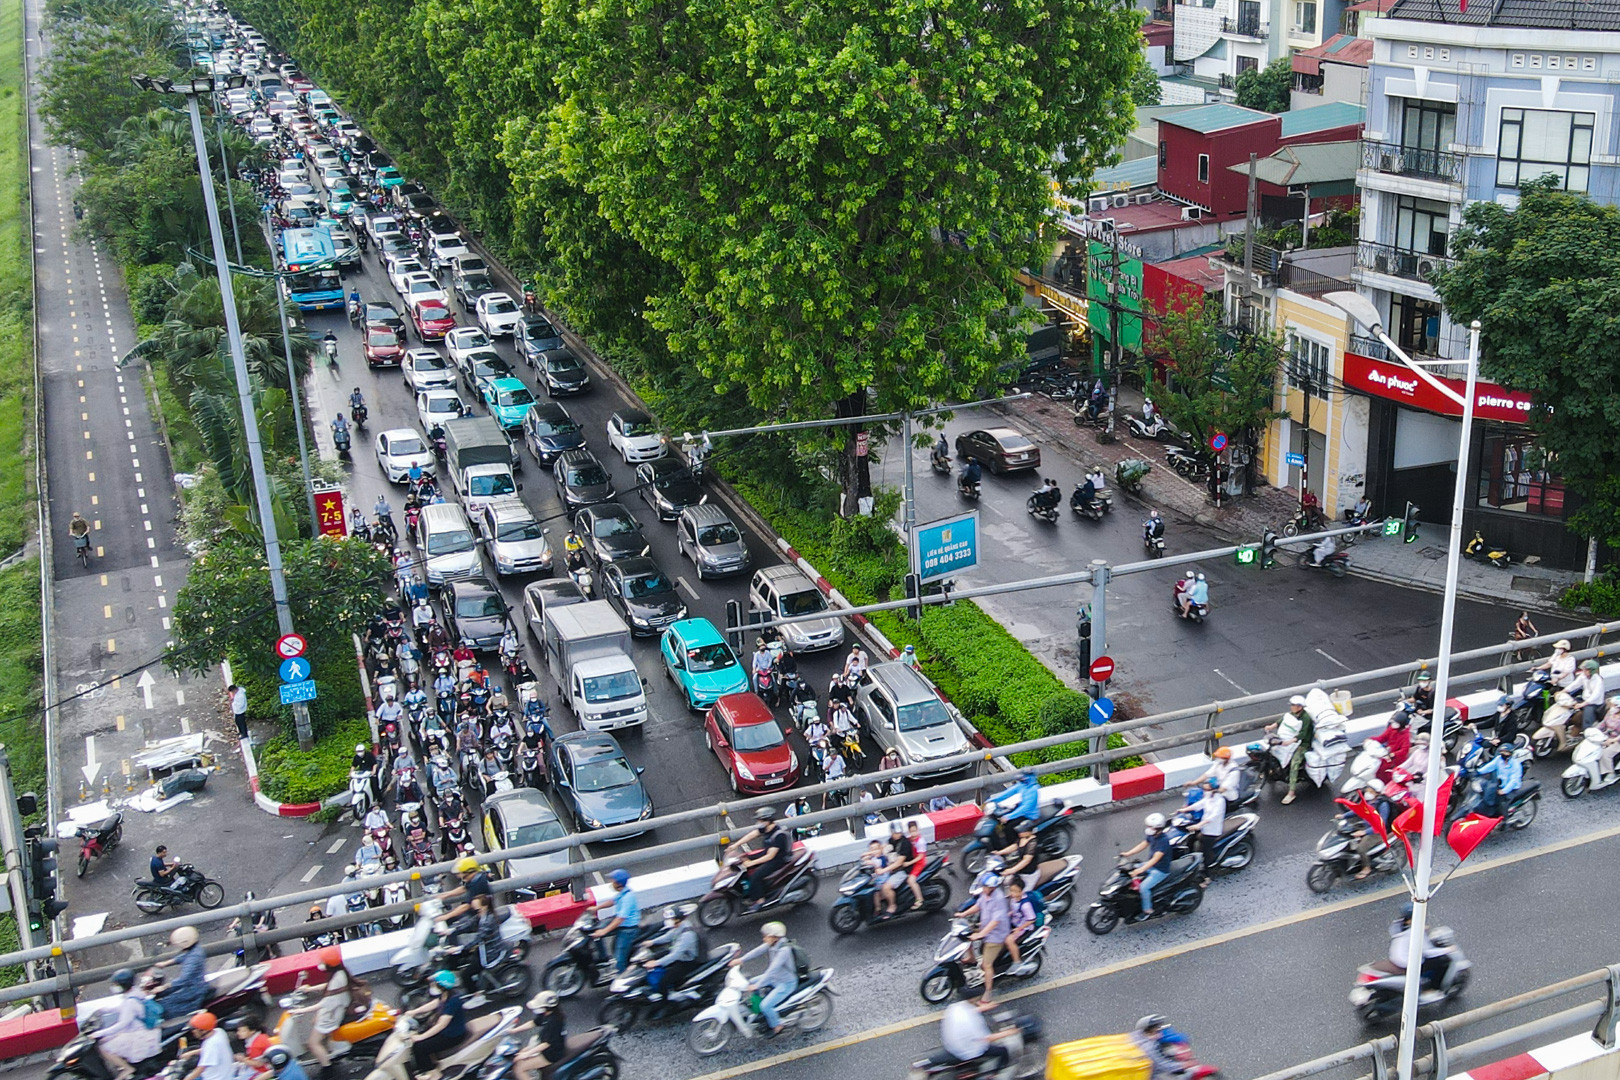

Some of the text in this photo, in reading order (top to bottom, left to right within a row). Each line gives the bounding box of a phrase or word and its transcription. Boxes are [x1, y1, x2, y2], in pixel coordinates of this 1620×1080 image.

[1119, 235, 1142, 257] Store
[1478, 395, 1514, 409] pierre
[321, 510, 342, 522] 7-5
[925, 548, 971, 569] 098 404 3333
